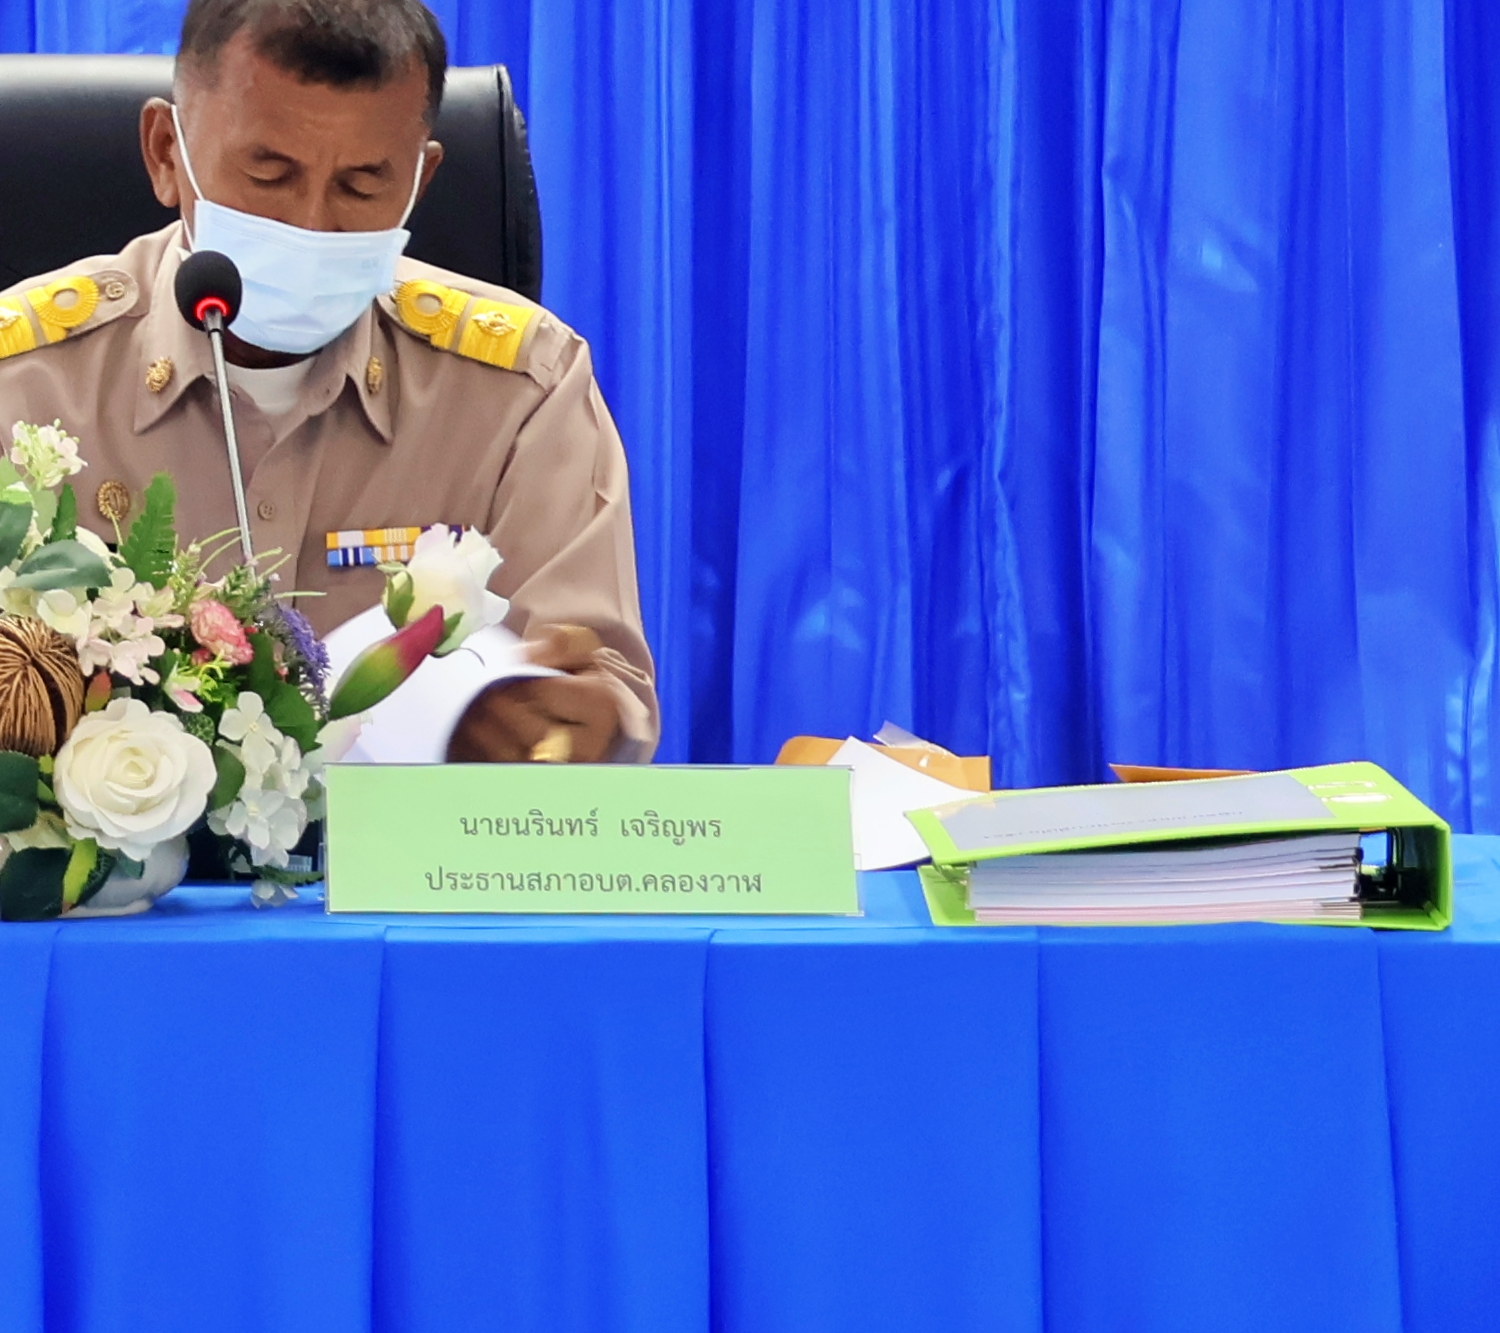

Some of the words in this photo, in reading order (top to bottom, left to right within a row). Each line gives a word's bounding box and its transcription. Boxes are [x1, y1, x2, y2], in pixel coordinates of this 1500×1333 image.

[459, 806, 600, 837] นายนรินทร์
[620, 809, 722, 846] เจริญพร
[424, 865, 763, 894] ประธานสภาอบต.คลองวาฬ
